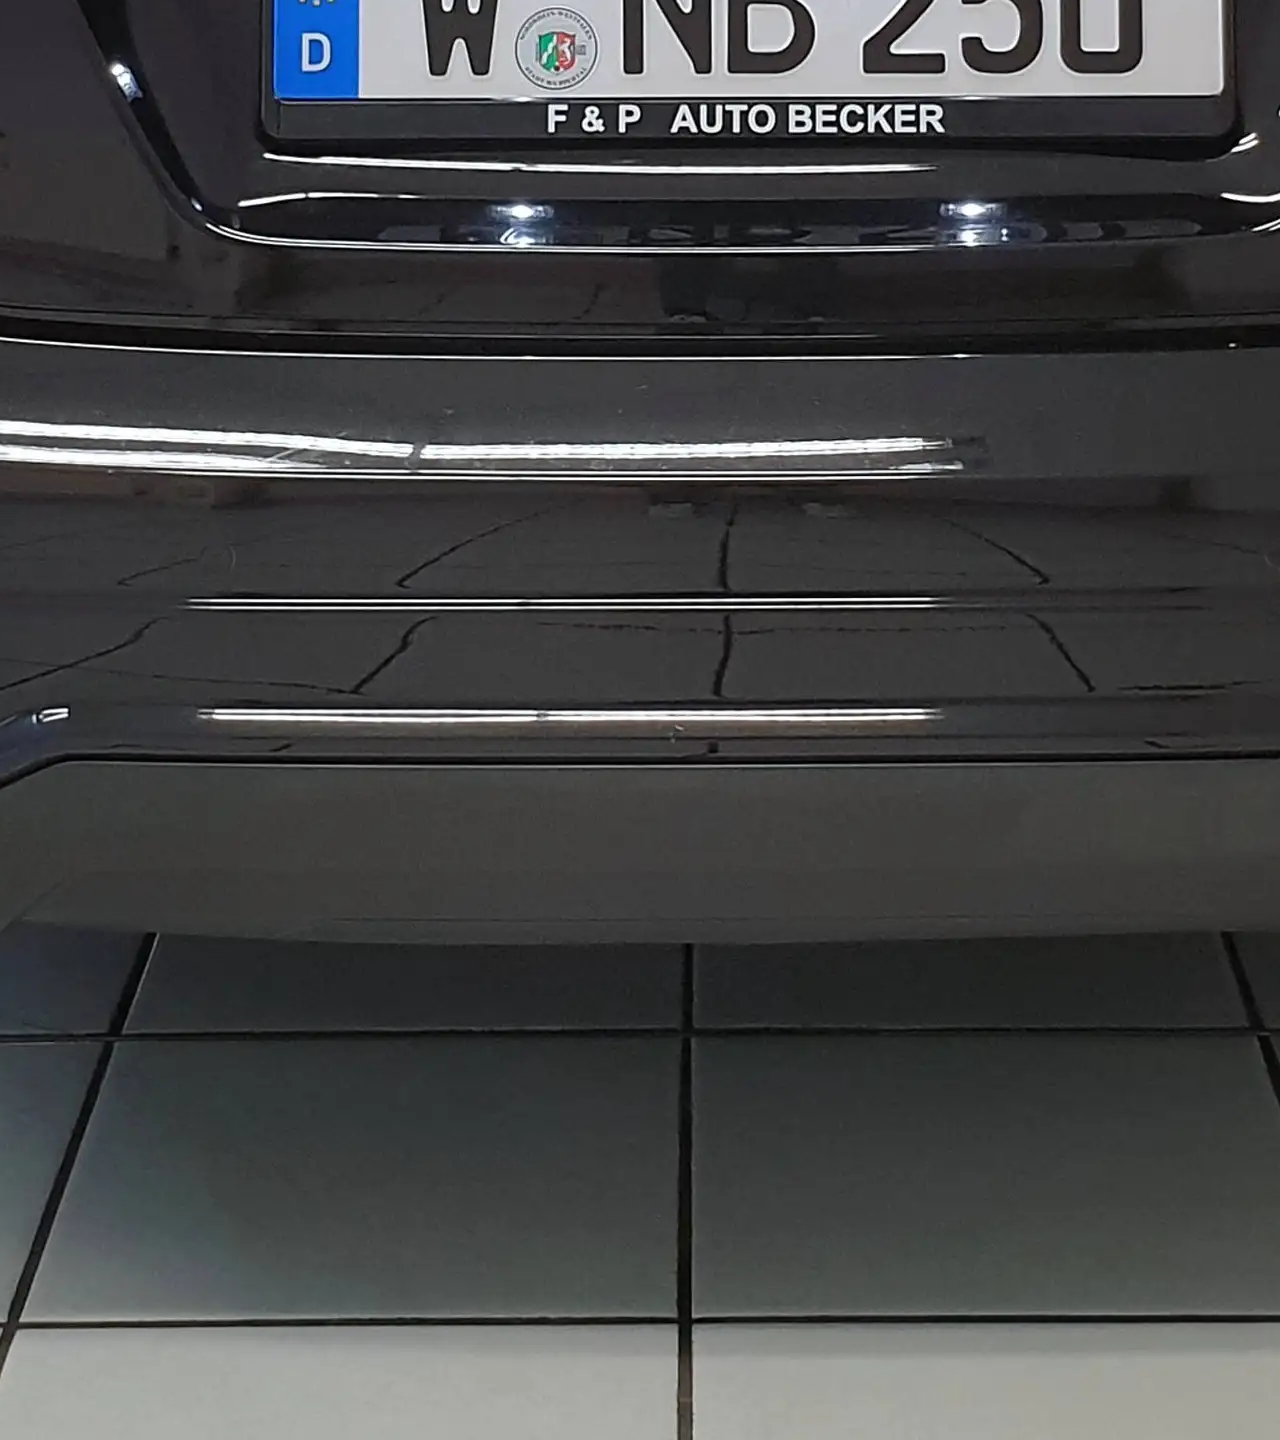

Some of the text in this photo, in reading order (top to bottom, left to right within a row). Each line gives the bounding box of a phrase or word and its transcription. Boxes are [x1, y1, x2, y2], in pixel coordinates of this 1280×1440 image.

[301, 33, 331, 72] D
[547, 104, 946, 134] F & P AUTO BECKER
